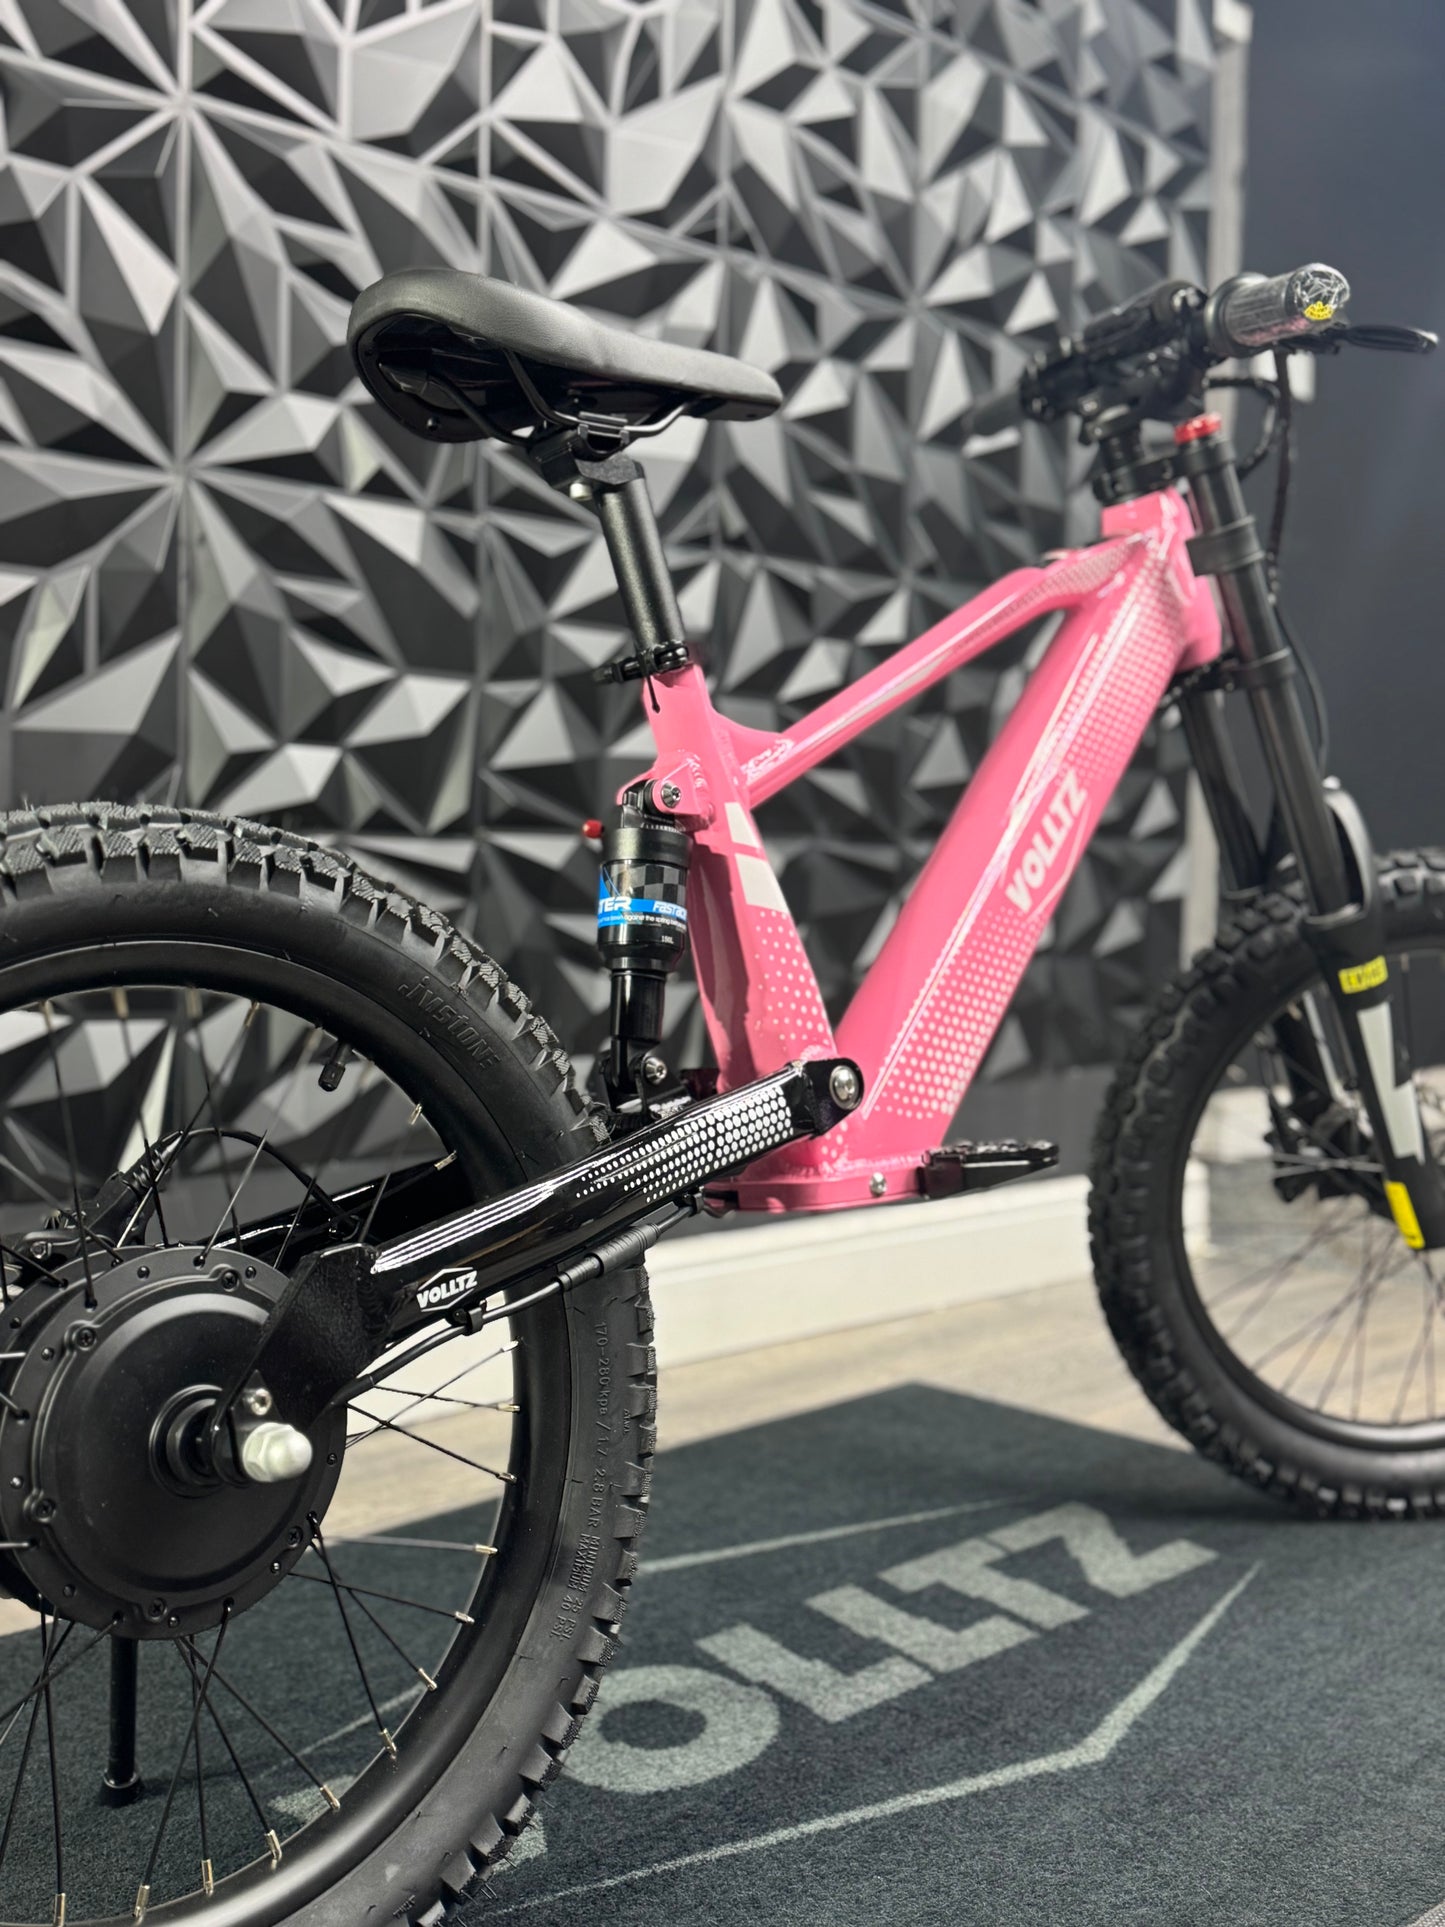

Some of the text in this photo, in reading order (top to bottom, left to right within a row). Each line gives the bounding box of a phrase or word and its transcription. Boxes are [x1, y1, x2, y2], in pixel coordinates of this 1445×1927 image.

[1004, 768, 1088, 914] VOLLTZ
[416, 1270, 478, 1309] VOLLTZ
[588, 1496, 603, 1527] BAR
[567, 1533, 591, 1590] MAXIMUM
[578, 1535, 600, 1593] MINIMUM
[561, 1594, 574, 1611] 40
[268, 1501, 1218, 1872] OLLTZ
